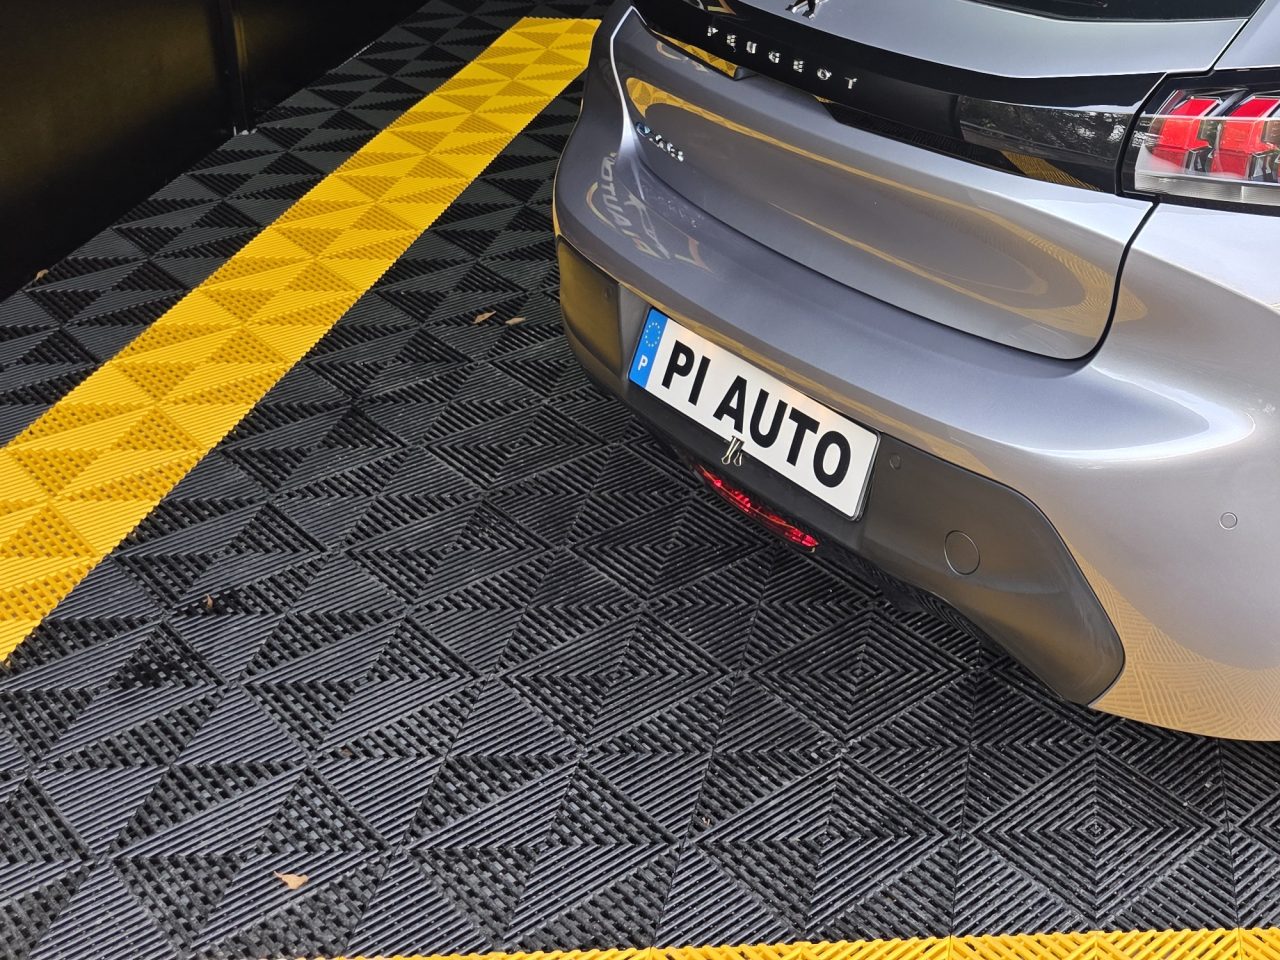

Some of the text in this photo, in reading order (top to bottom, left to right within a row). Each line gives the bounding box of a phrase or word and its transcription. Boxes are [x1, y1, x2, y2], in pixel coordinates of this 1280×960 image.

[707, 25, 858, 90] PEUGEOT
[637, 339, 851, 488] P PI AUTO
